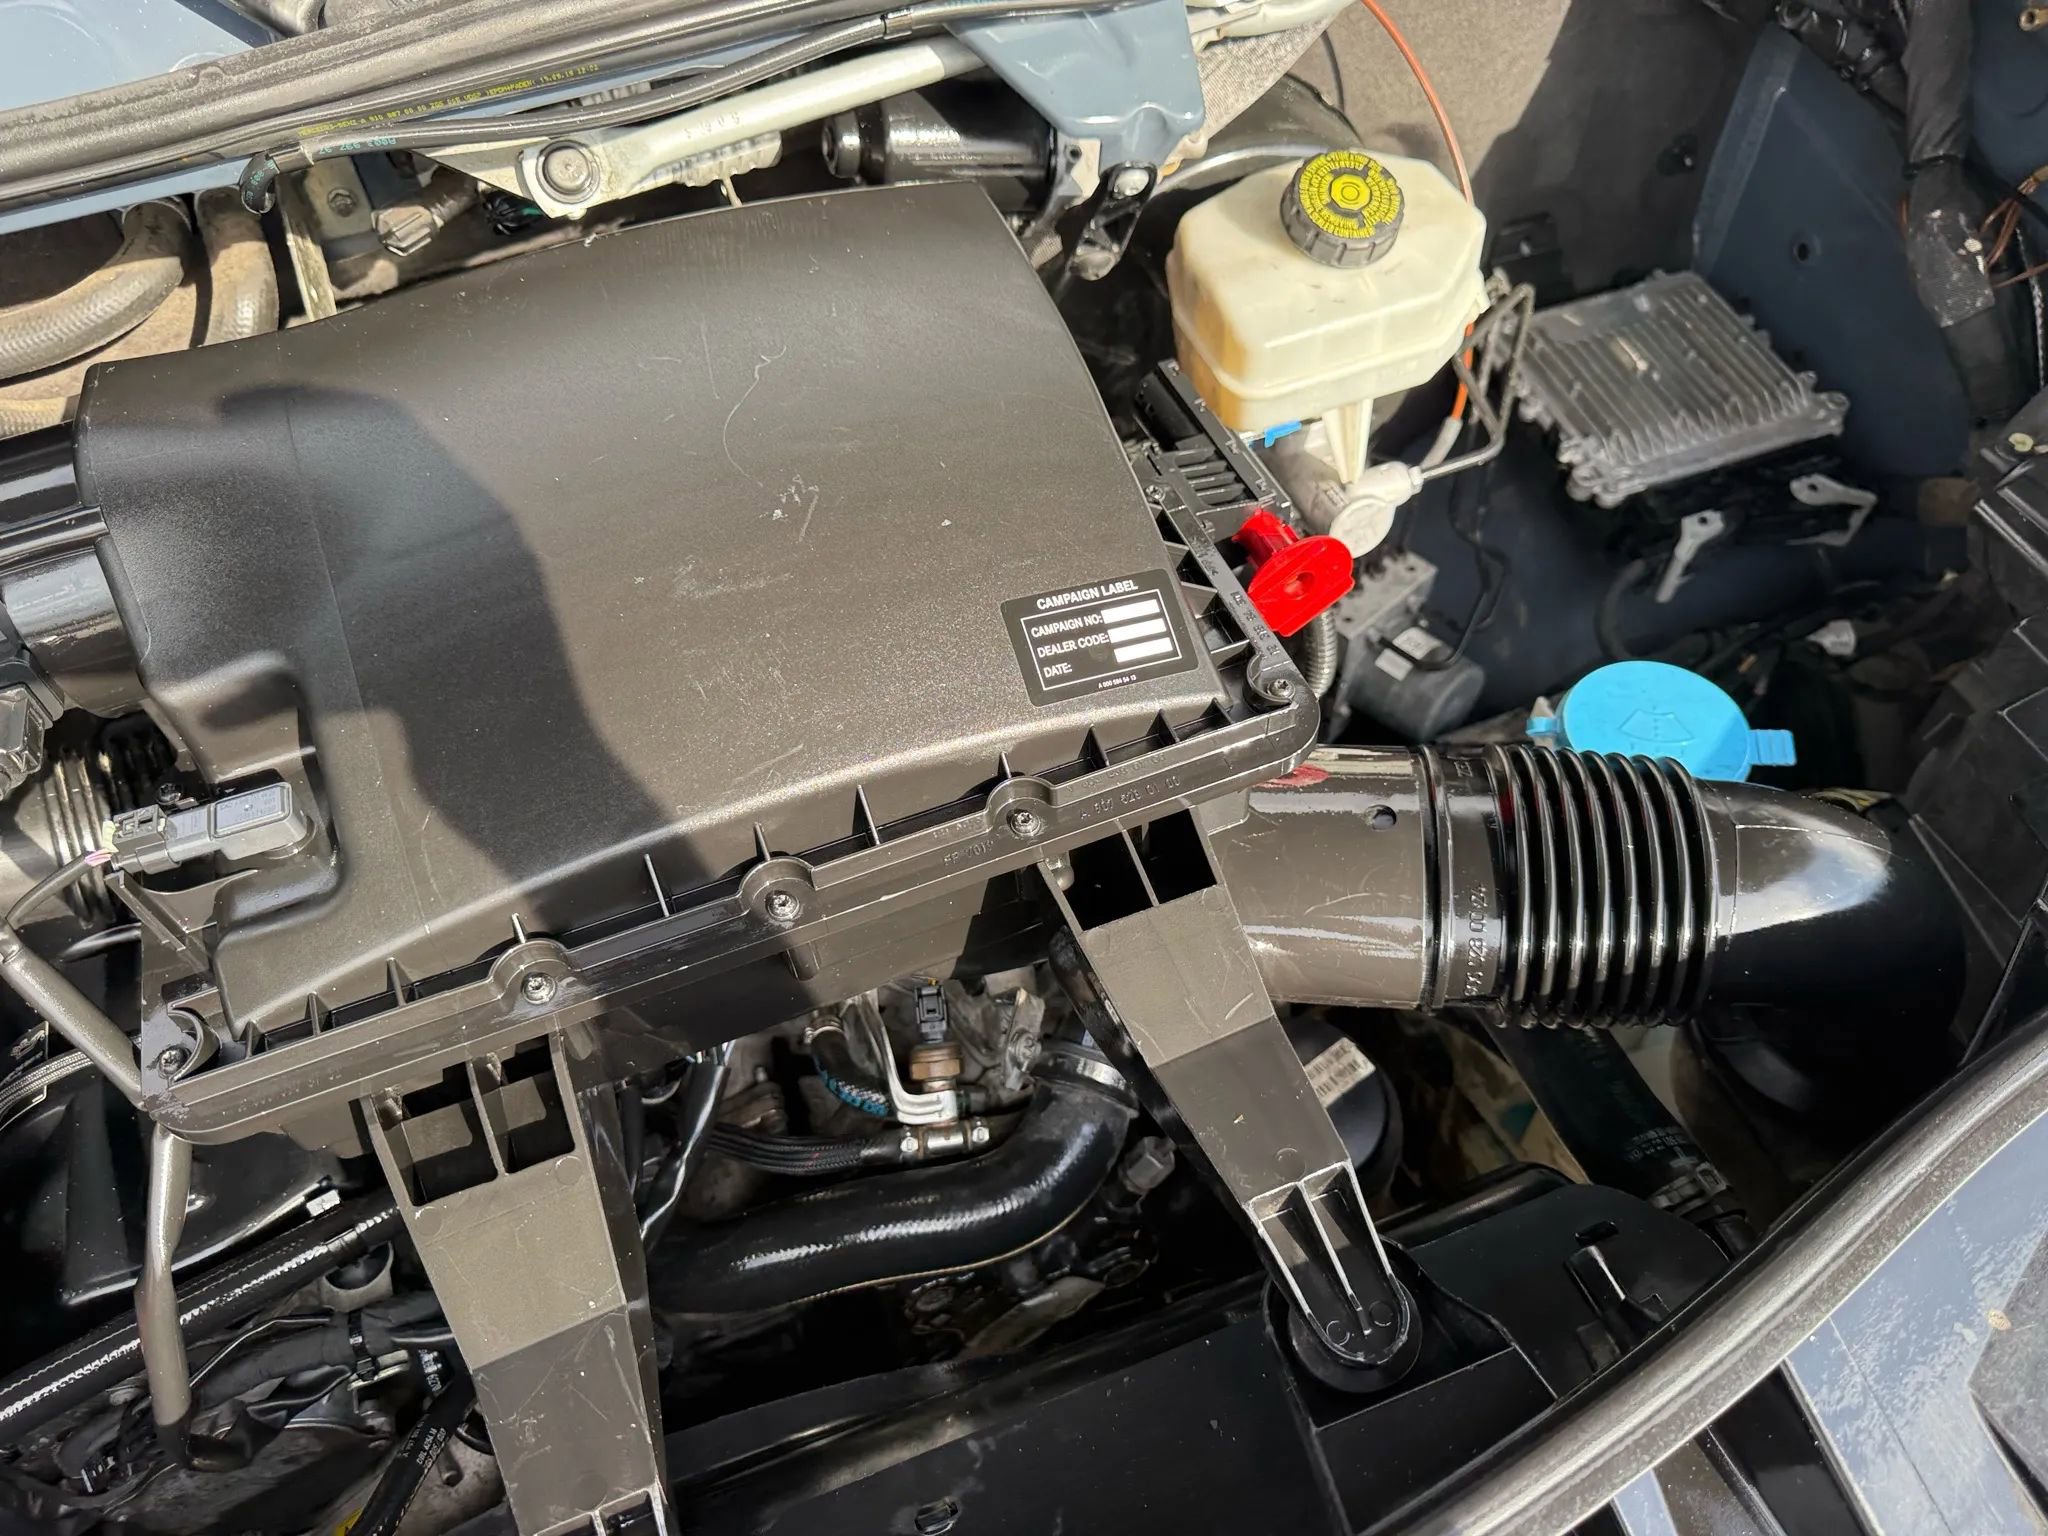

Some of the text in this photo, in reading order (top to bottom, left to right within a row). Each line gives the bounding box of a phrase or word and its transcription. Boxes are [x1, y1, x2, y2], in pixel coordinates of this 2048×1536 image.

[1036, 580, 1138, 610] CAMPAIGN LABEL
[1031, 614, 1103, 638] CAMPAIGN NO:
[1037, 633, 1109, 658] DEALER CODE:
[1044, 662, 1072, 678] DATE:
